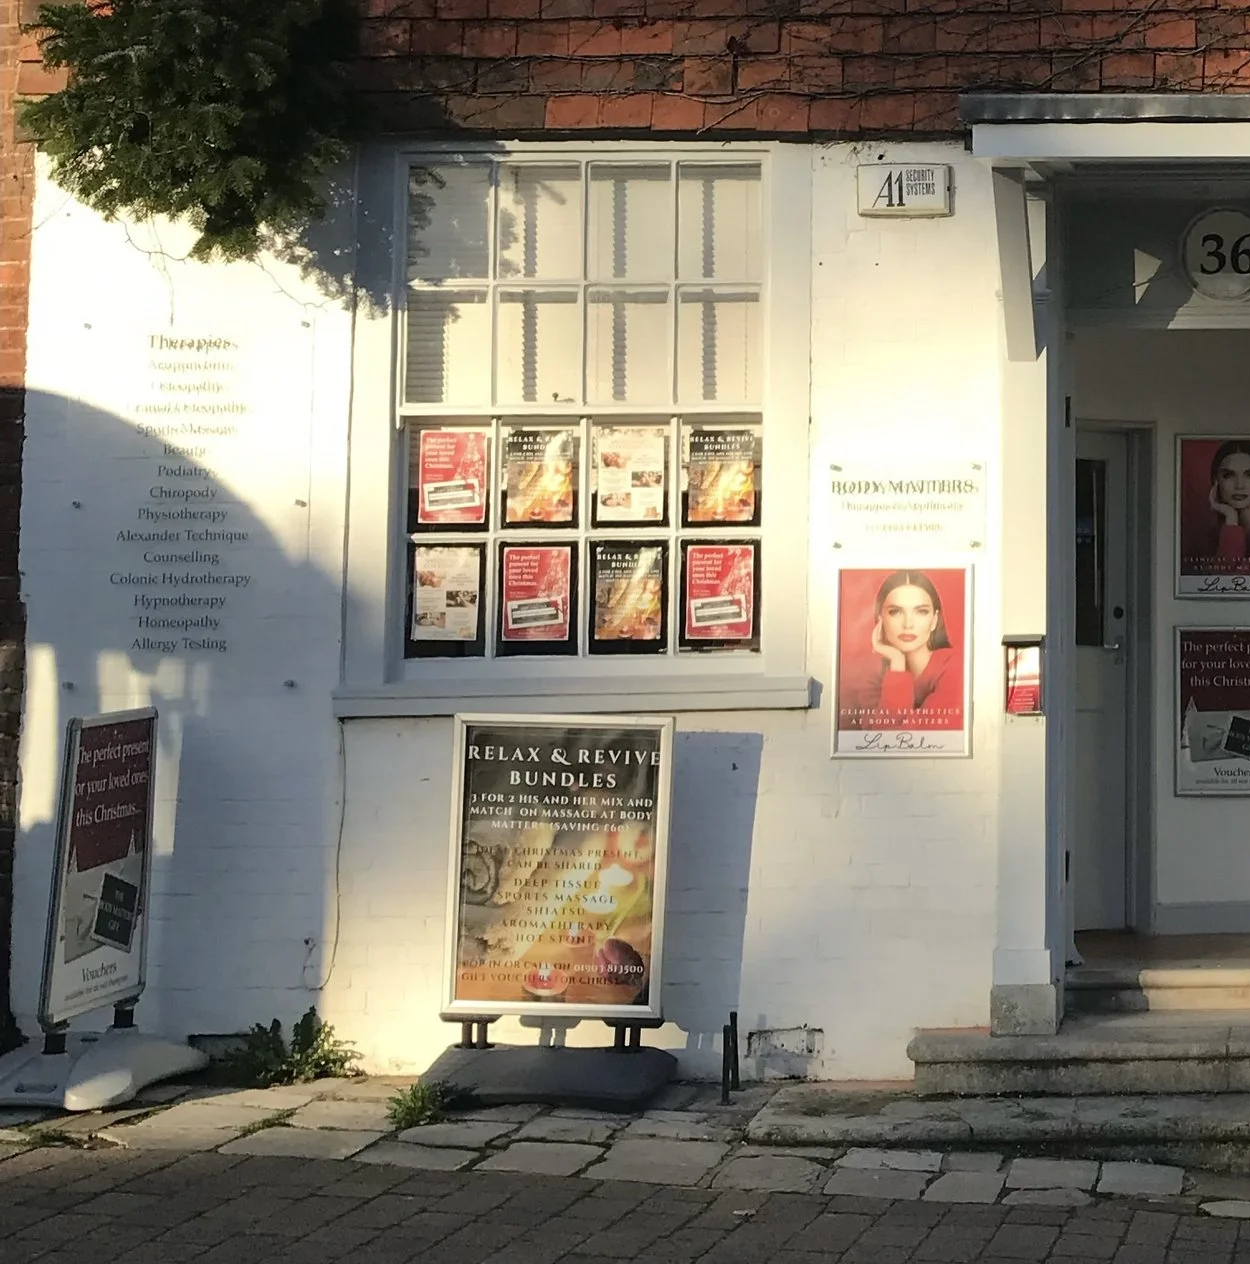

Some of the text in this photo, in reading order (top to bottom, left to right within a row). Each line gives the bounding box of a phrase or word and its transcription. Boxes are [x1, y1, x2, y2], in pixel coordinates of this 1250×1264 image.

[906, 169, 934, 182] SECURITY
[872, 171, 905, 208] A1
[906, 182, 936, 196] SYSTEMS
[147, 334, 234, 354] Therapies
[164, 444, 207, 458] Beauty
[158, 465, 214, 479] Podiatry
[150, 487, 217, 501] Chiropody
[138, 508, 227, 522] Physiotherapy
[116, 529, 248, 544] Alexander Technique
[144, 551, 219, 564] Counselling
[110, 573, 251, 587] Colonic Hydrotherapy
[134, 594, 226, 609] Hypnotherapy
[138, 616, 220, 630] Homeopathy
[131, 638, 227, 653] Allergy Testing
[1182, 641, 1203, 653] The
[1206, 640, 1244, 656] perfect
[1182, 659, 1197, 669] for
[1200, 660, 1226, 672] your
[1190, 676, 1210, 687] this
[856, 732, 945, 752] Lip Balm
[93, 741, 121, 768] perfect
[122, 738, 150, 763] present
[468, 745, 660, 766] RELAX & REVIVE
[74, 781, 86, 796] or
[86, 778, 108, 801] your
[108, 769, 130, 790] loved
[510, 770, 617, 789] BUNDLES
[472, 793, 653, 808] 3 FOR 2 HIS AND HER MIX AND
[76, 807, 93, 827] this
[470, 806, 653, 821] MATCH ON MASSAGE AT BODY
[514, 846, 583, 857] CHRISTMAS
[507, 860, 532, 868] CAN
[536, 860, 550, 870] BE
[514, 878, 600, 890] DEEP TISSUE
[498, 891, 617, 904] SPORTS MASSAGE
[526, 906, 586, 916] SHIATSU
[501, 919, 611, 932] AROMATHERAPY
[516, 934, 594, 944] HOT STONE
[82, 962, 117, 982] Vouchers
[462, 959, 485, 968] POP
[488, 960, 501, 968] IN
[504, 960, 520, 968] OR
[607, 964, 644, 974] 813500
